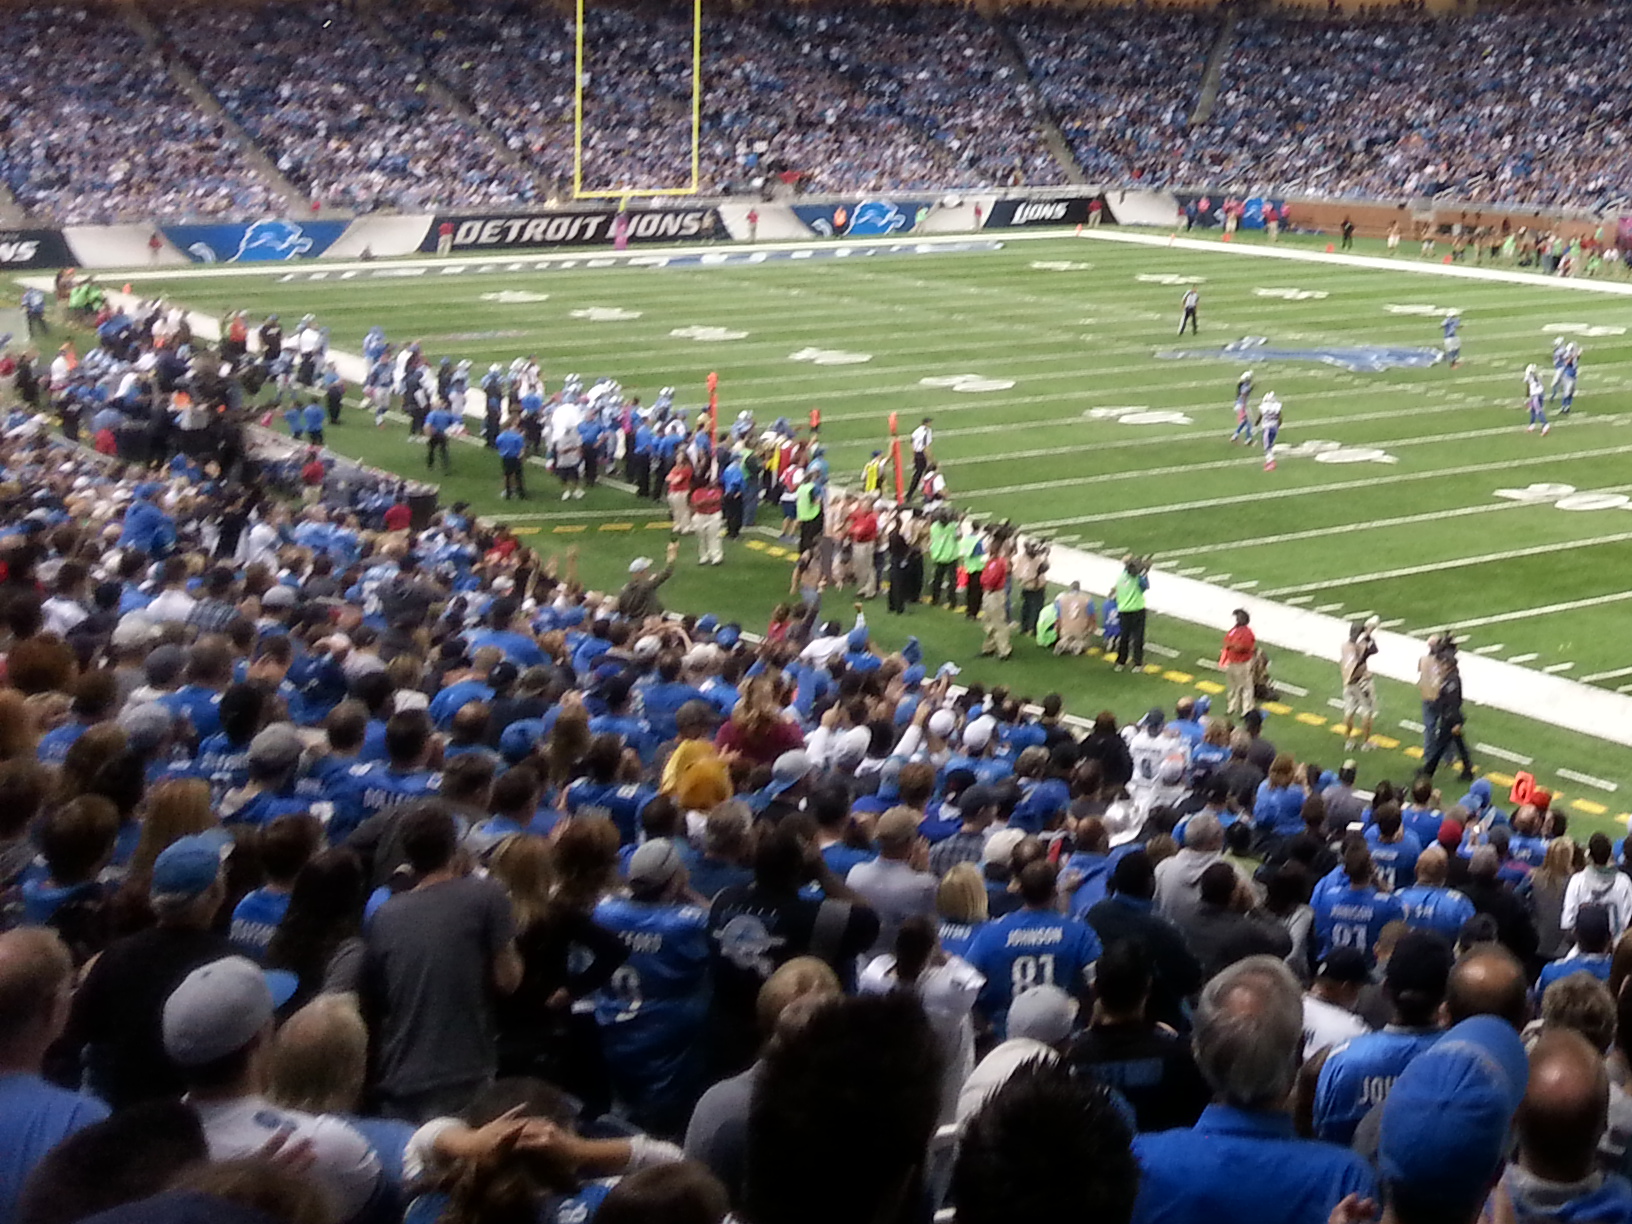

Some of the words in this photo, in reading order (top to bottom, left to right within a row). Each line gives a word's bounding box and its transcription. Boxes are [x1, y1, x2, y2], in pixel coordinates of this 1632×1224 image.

[1011, 201, 1070, 225] LIONS
[452, 214, 605, 246] DETROIT
[1005, 926, 1063, 947] JOHNSON
